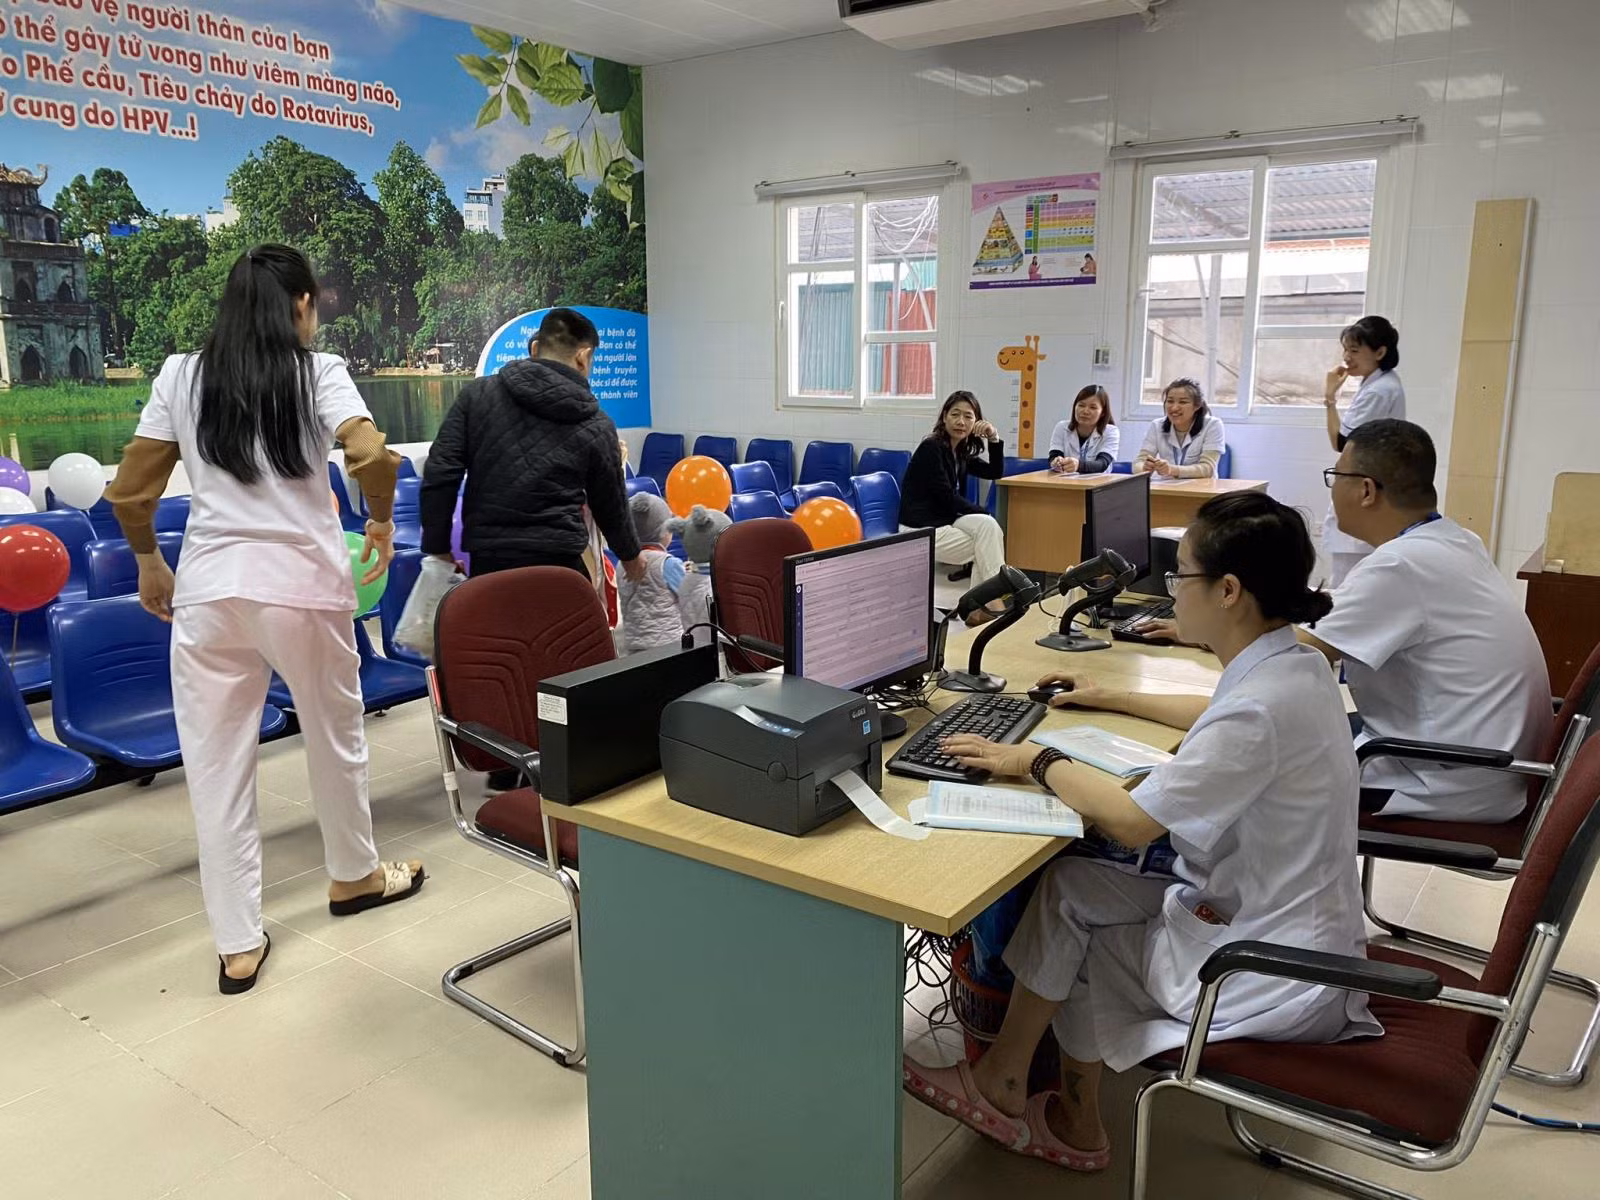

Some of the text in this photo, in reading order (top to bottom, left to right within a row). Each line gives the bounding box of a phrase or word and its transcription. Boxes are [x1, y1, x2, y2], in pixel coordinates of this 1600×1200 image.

[127, 3, 190, 31] người
[198, 14, 245, 42] thân
[251, 26, 286, 51] của
[293, 32, 329, 62] bạn
[14, 14, 56, 42] thể
[65, 26, 110, 57] gây
[118, 34, 142, 57] tử
[148, 44, 201, 73] vong
[210, 52, 247, 76] như
[253, 61, 299, 87] viêm
[307, 72, 357, 101] màng
[363, 83, 399, 107] não,
[26, 54, 73, 83] Phế
[82, 64, 132, 96] cầu,
[139, 72, 187, 101] Tiêu
[195, 84, 244, 115] chảy
[252, 93, 276, 116] do
[283, 97, 372, 133] Rotavirus,
[13, 97, 76, 127] cung
[84, 103, 114, 127] do
[122, 106, 196, 138] HPV...!
[607, 327, 624, 339] bệnh
[615, 341, 623, 349] có
[593, 365, 611, 376] bệnh
